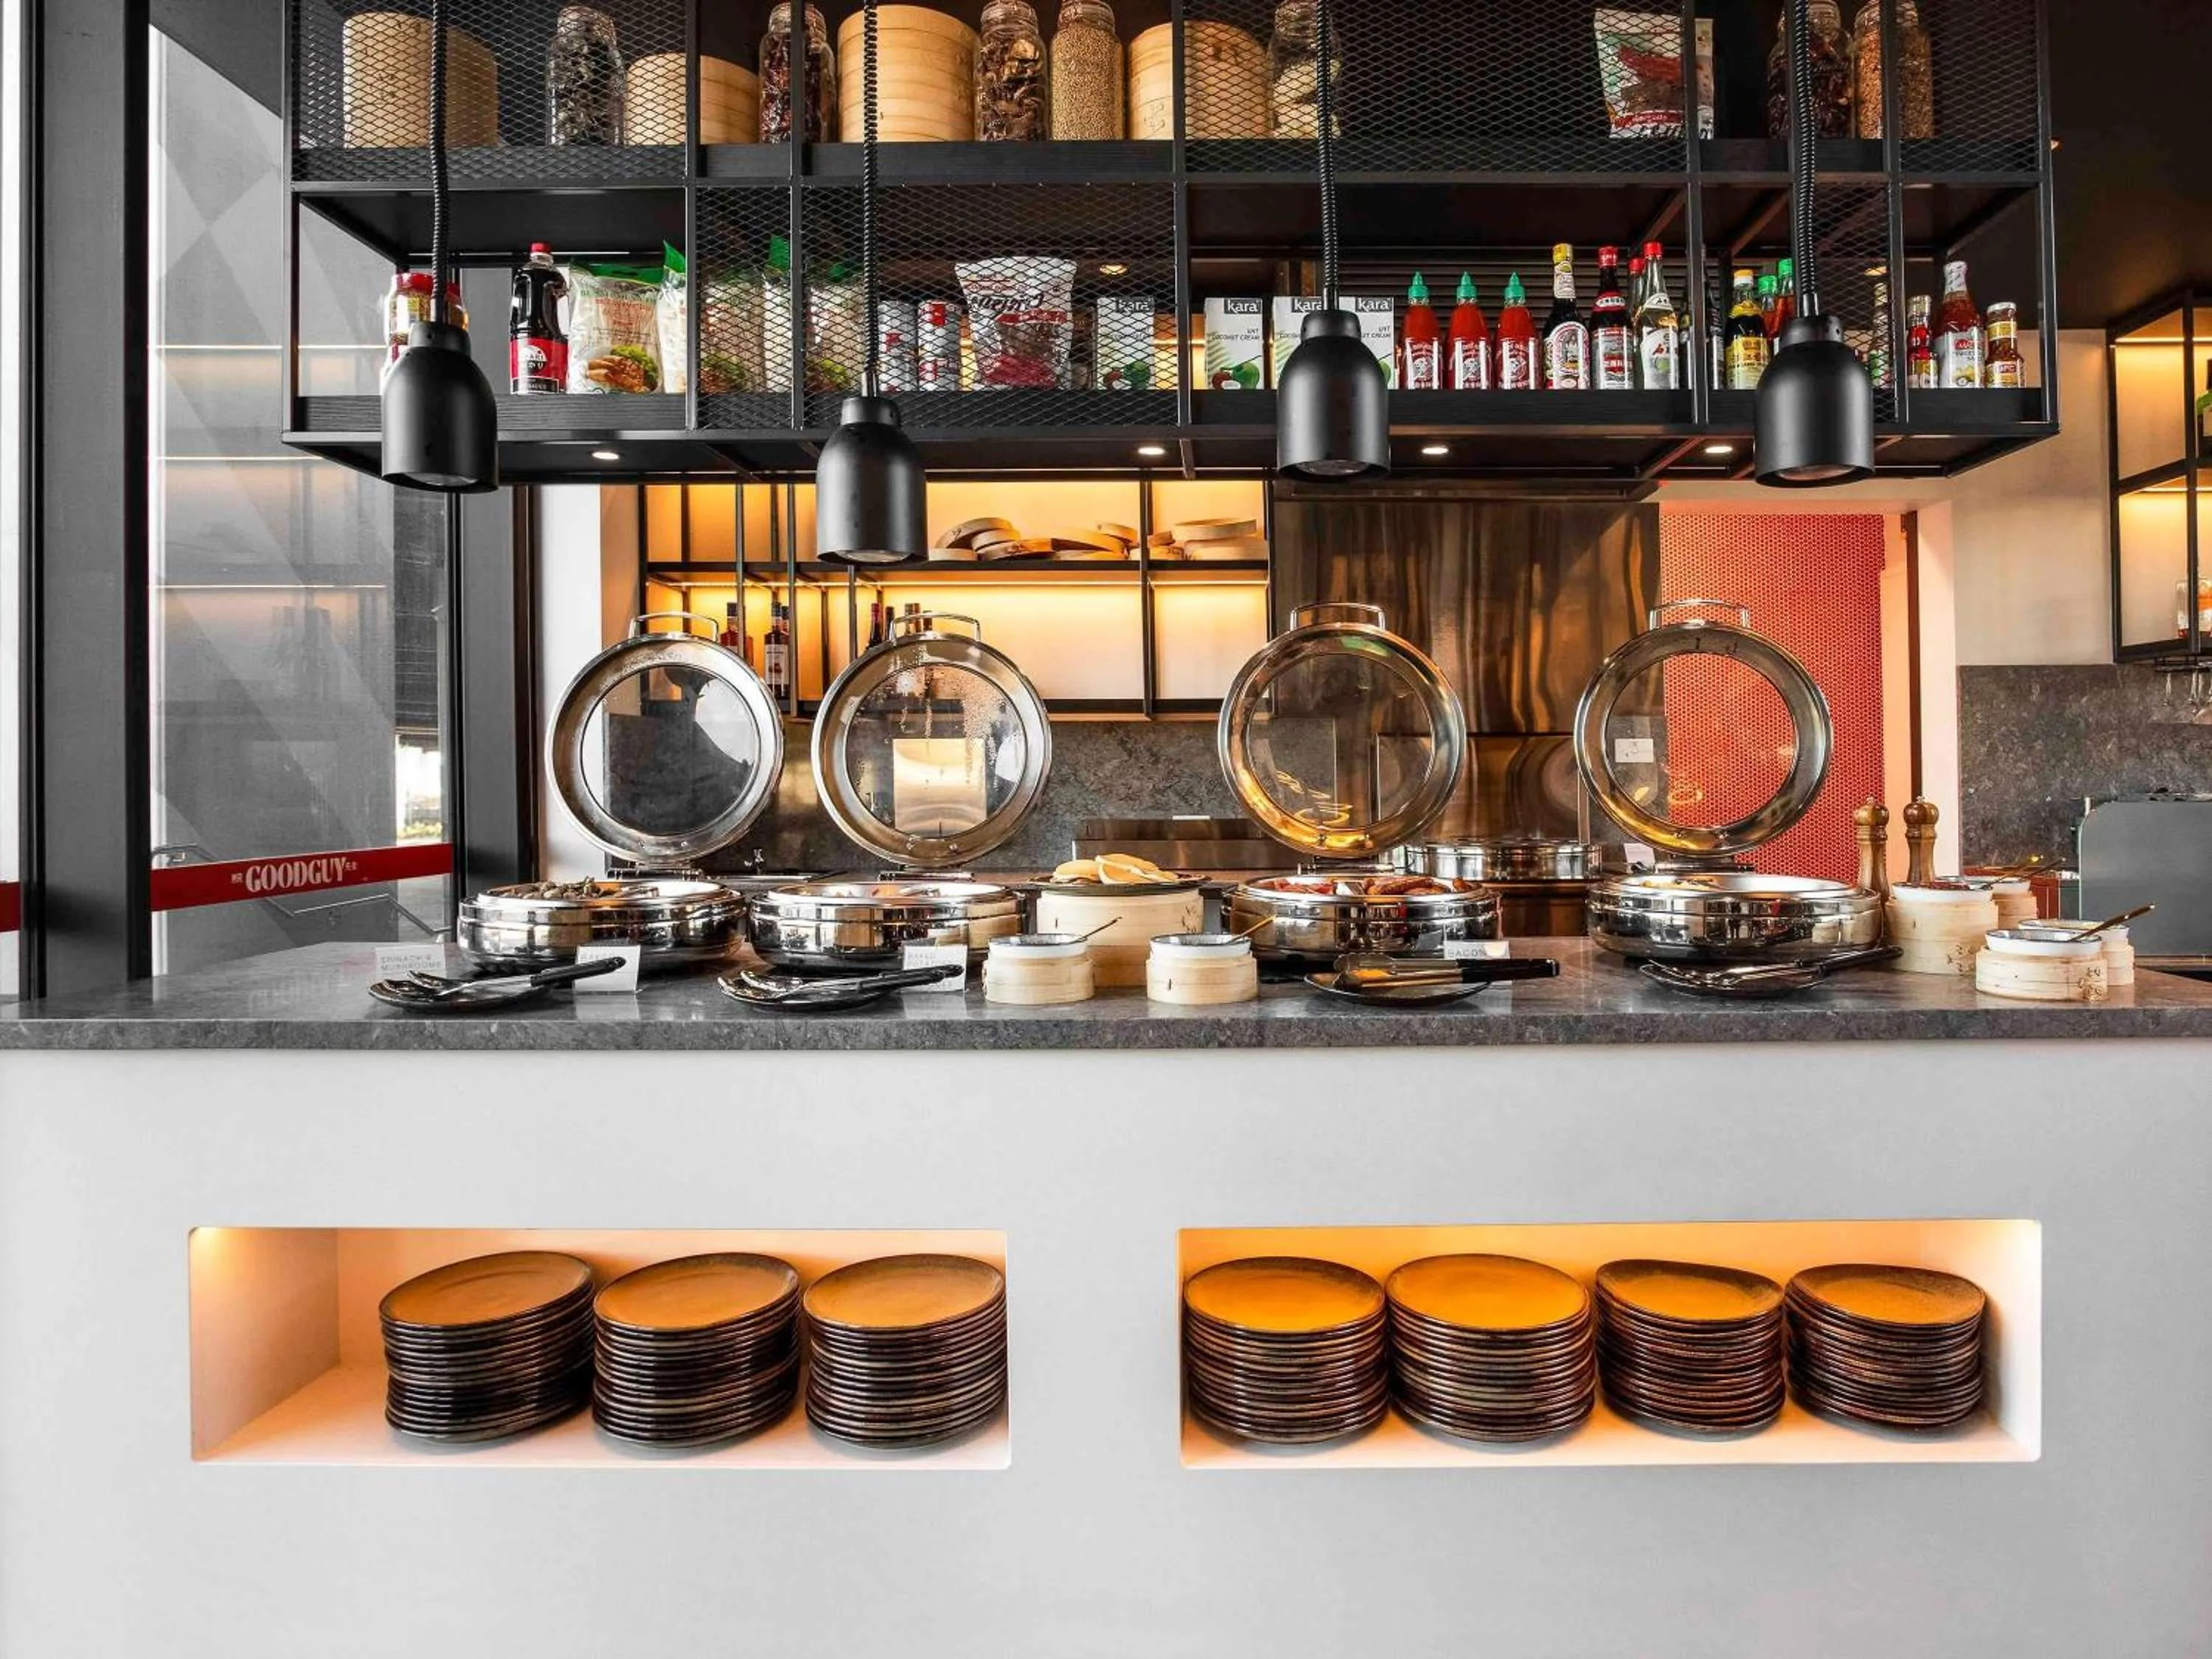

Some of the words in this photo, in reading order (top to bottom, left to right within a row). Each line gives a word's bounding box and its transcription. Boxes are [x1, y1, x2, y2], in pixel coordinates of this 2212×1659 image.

[1227, 299, 1259, 313] kara
[1293, 297, 1323, 312] kara
[1357, 297, 1391, 312] kara
[245, 856, 347, 893] GOODGUY
